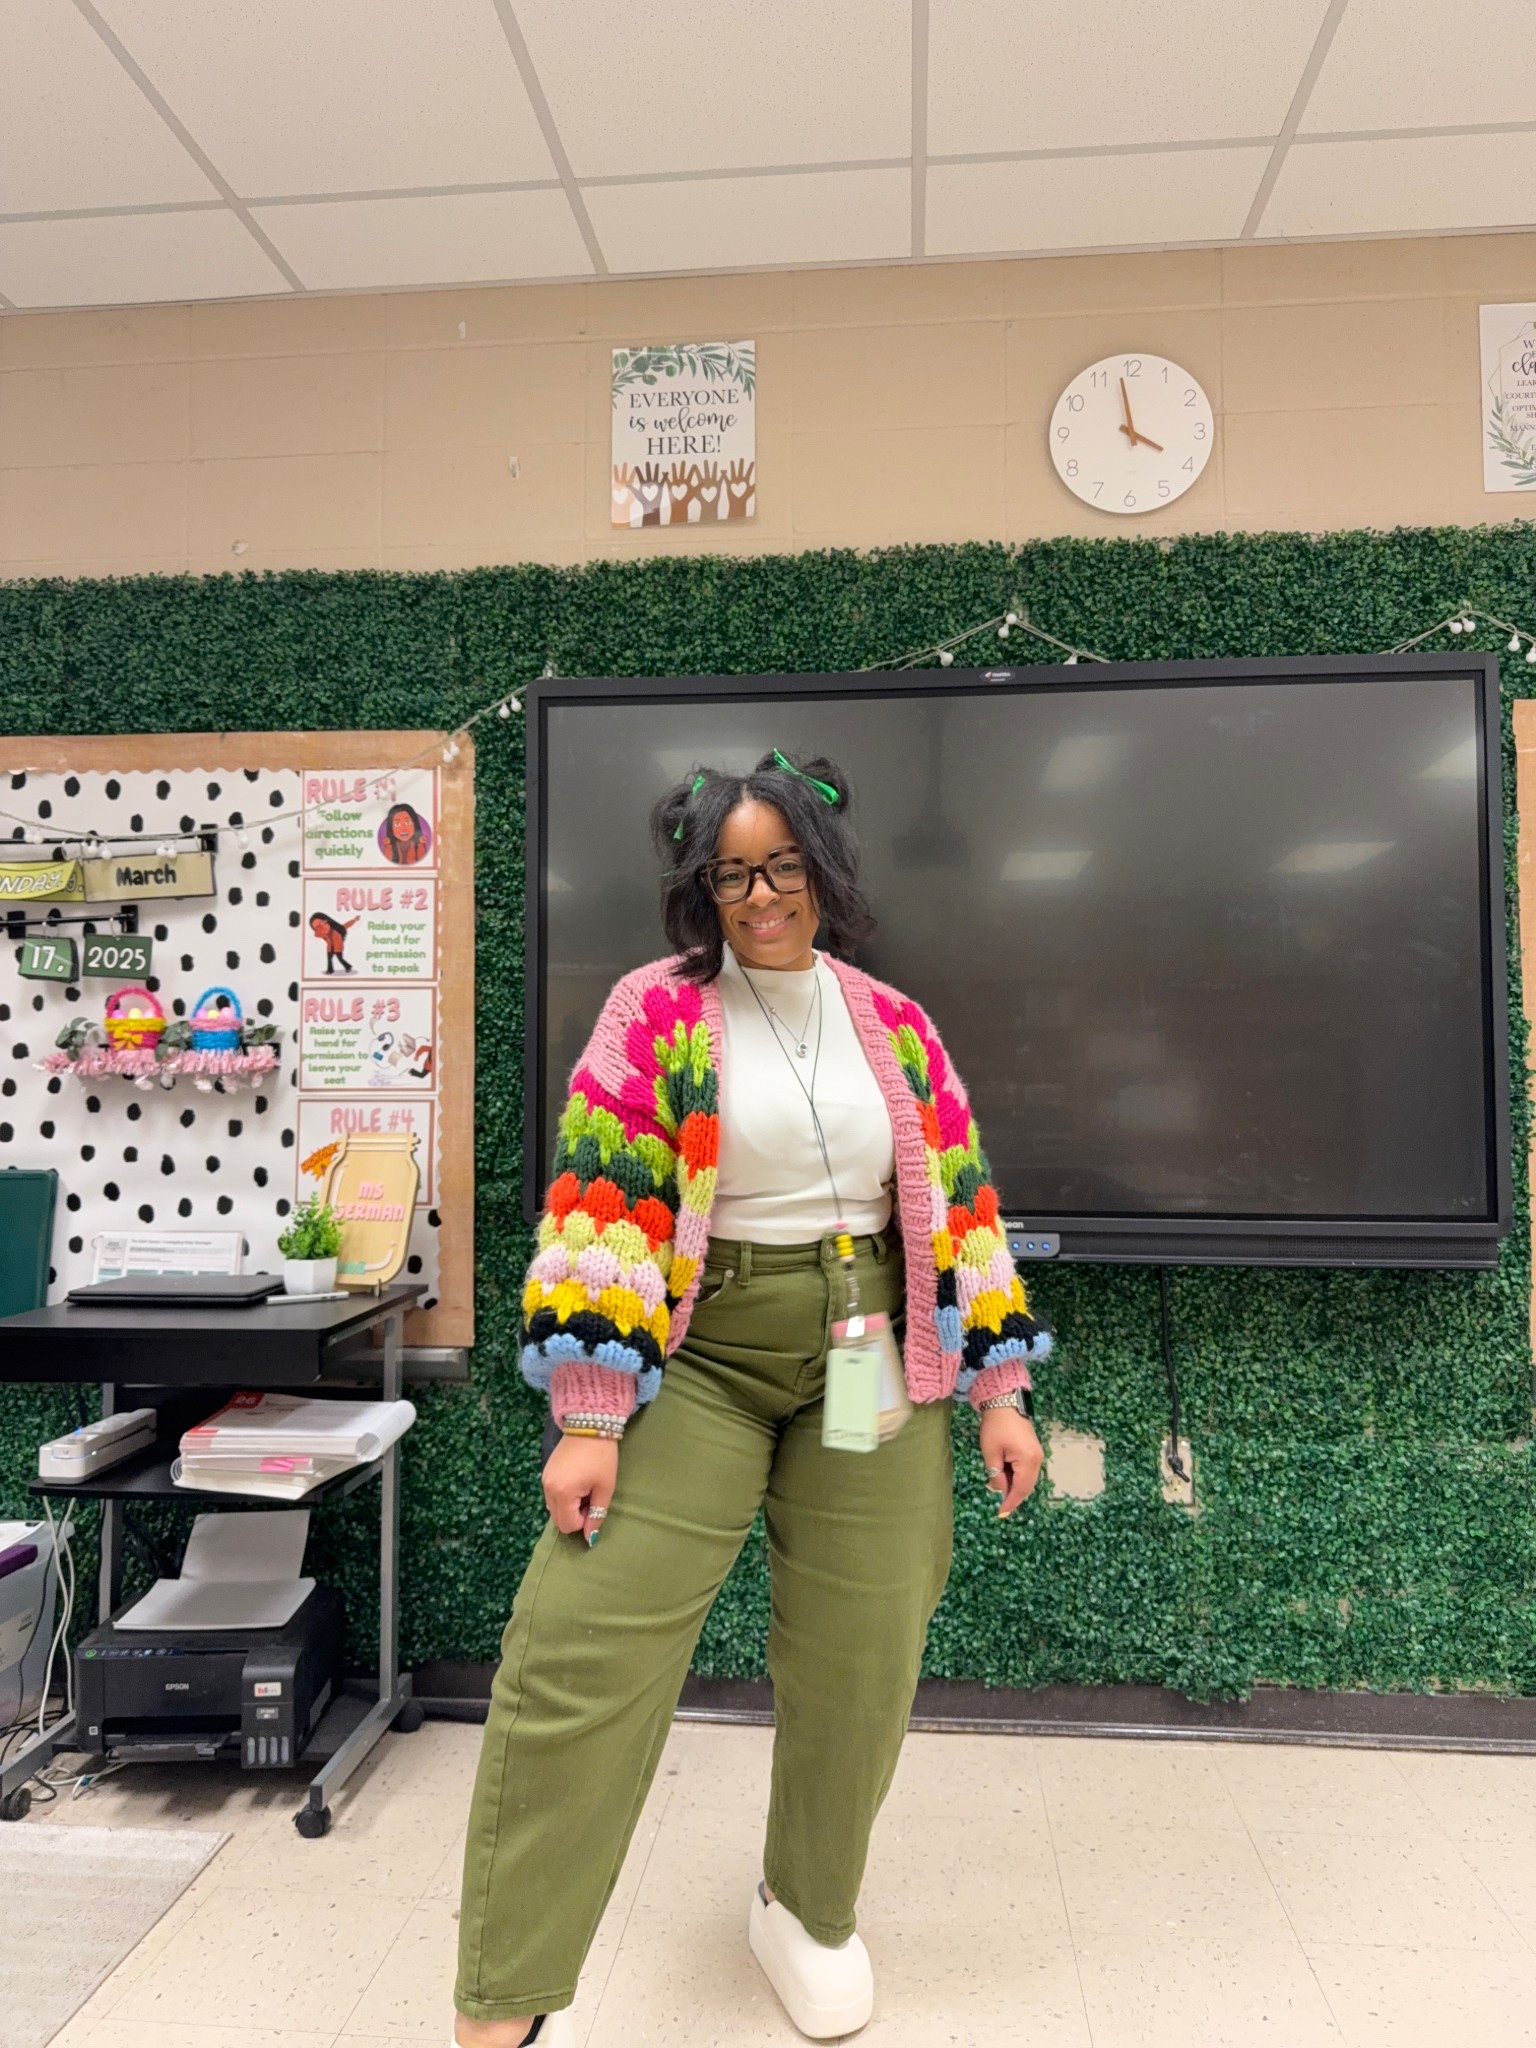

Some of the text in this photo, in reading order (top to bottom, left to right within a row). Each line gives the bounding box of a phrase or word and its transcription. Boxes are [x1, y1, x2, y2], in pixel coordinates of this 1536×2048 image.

[1123, 359, 1142, 378] 12
[1161, 367, 1168, 384] 1
[1090, 371, 1107, 388] 11
[629, 389, 739, 409] EVERYONE
[1066, 394, 1084, 412] 10
[1184, 389, 1197, 407] 2
[629, 406, 738, 433] is welcome
[1057, 427, 1070, 444] 9
[1193, 422, 1206, 440] 3
[646, 435, 721, 456] HERE!
[1066, 459, 1079, 477] 8
[1181, 456, 1194, 472] 4
[1092, 481, 1104, 499] 7
[1158, 480, 1171, 498] 5
[1123, 490, 1136, 507] 6
[306, 777, 367, 804] RULE
[315, 843, 364, 860] quickly
[116, 863, 177, 887] March
[336, 887, 429, 912] RULE #2
[367, 920, 426, 933] Raise your
[372, 934, 421, 945] hand for
[31, 945, 65, 973] 17.
[87, 946, 146, 971] 2025
[365, 949, 427, 961] permission
[372, 963, 420, 976] to speak
[304, 996, 401, 1023] RULE #3
[309, 1026, 362, 1037] Raise your
[314, 1039, 357, 1048] hand for
[302, 1051, 369, 1062] permission to
[308, 1063, 362, 1074] leave your
[323, 1076, 346, 1085] seat
[330, 1107, 415, 1134] RULE #4
[358, 1182, 384, 1200] MS
[165, 1682, 190, 1691] EPSON
